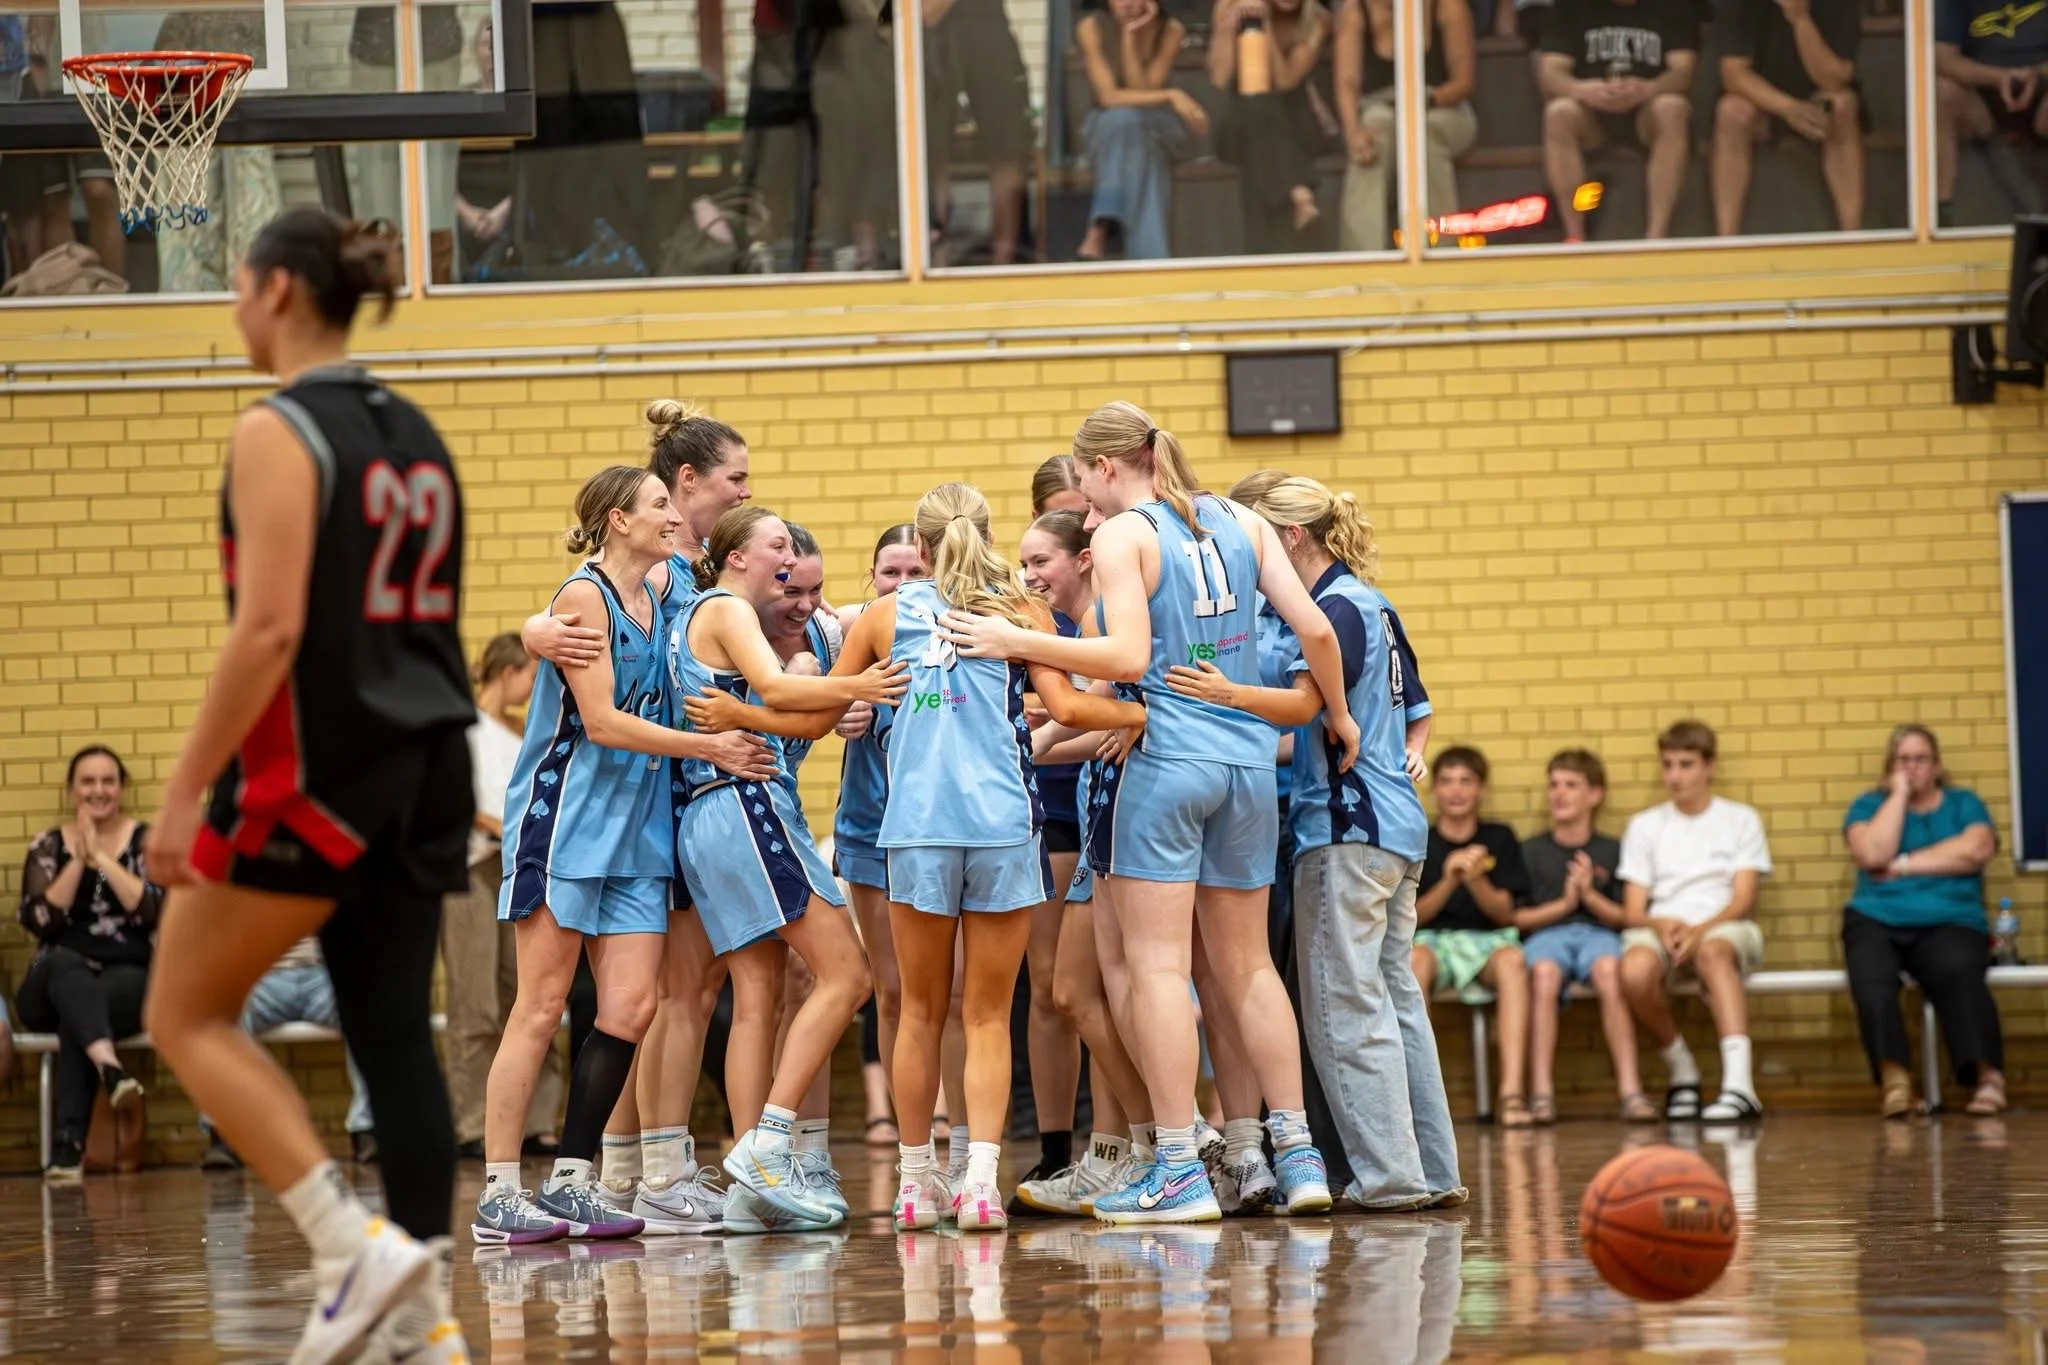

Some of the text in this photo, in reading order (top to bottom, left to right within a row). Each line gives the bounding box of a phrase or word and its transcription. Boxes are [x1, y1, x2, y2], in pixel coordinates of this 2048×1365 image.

[1584, 27, 1661, 66] TOKYO
[362, 458, 455, 622] 22
[1182, 536, 1237, 618] 11
[1187, 642, 1216, 664] yes
[914, 692, 941, 713] ye
[1095, 1141, 1118, 1161] WA
